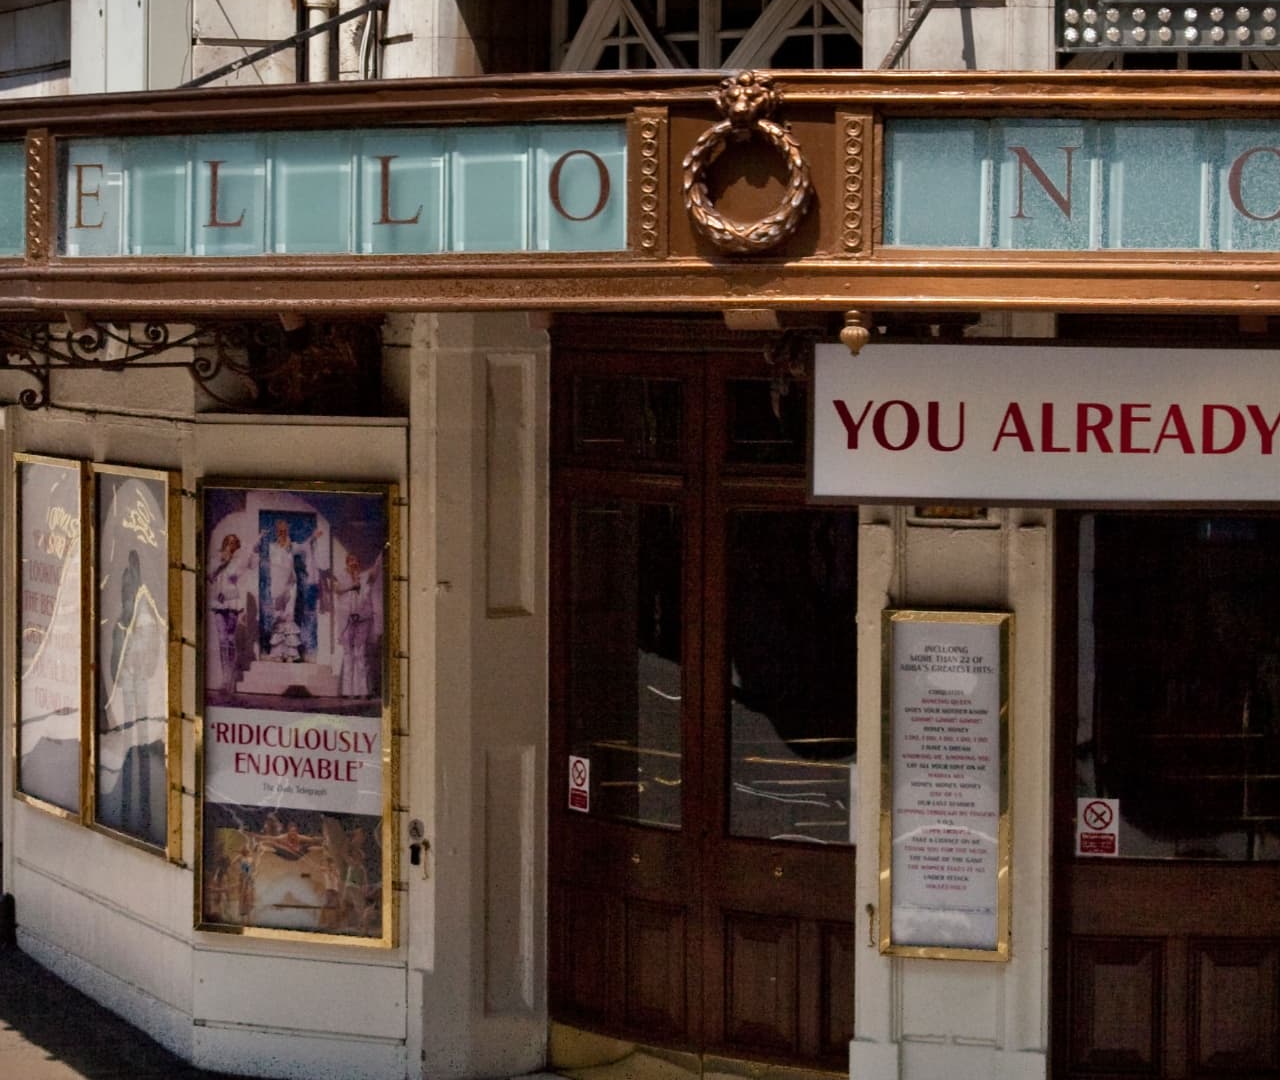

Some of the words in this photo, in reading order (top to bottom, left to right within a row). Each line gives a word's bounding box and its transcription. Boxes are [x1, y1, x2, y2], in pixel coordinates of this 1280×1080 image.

[835, 400, 967, 454] YOU
[210, 722, 378, 755] 'RIDICULOUSLY
[234, 752, 364, 783] ENJOYABLE'
